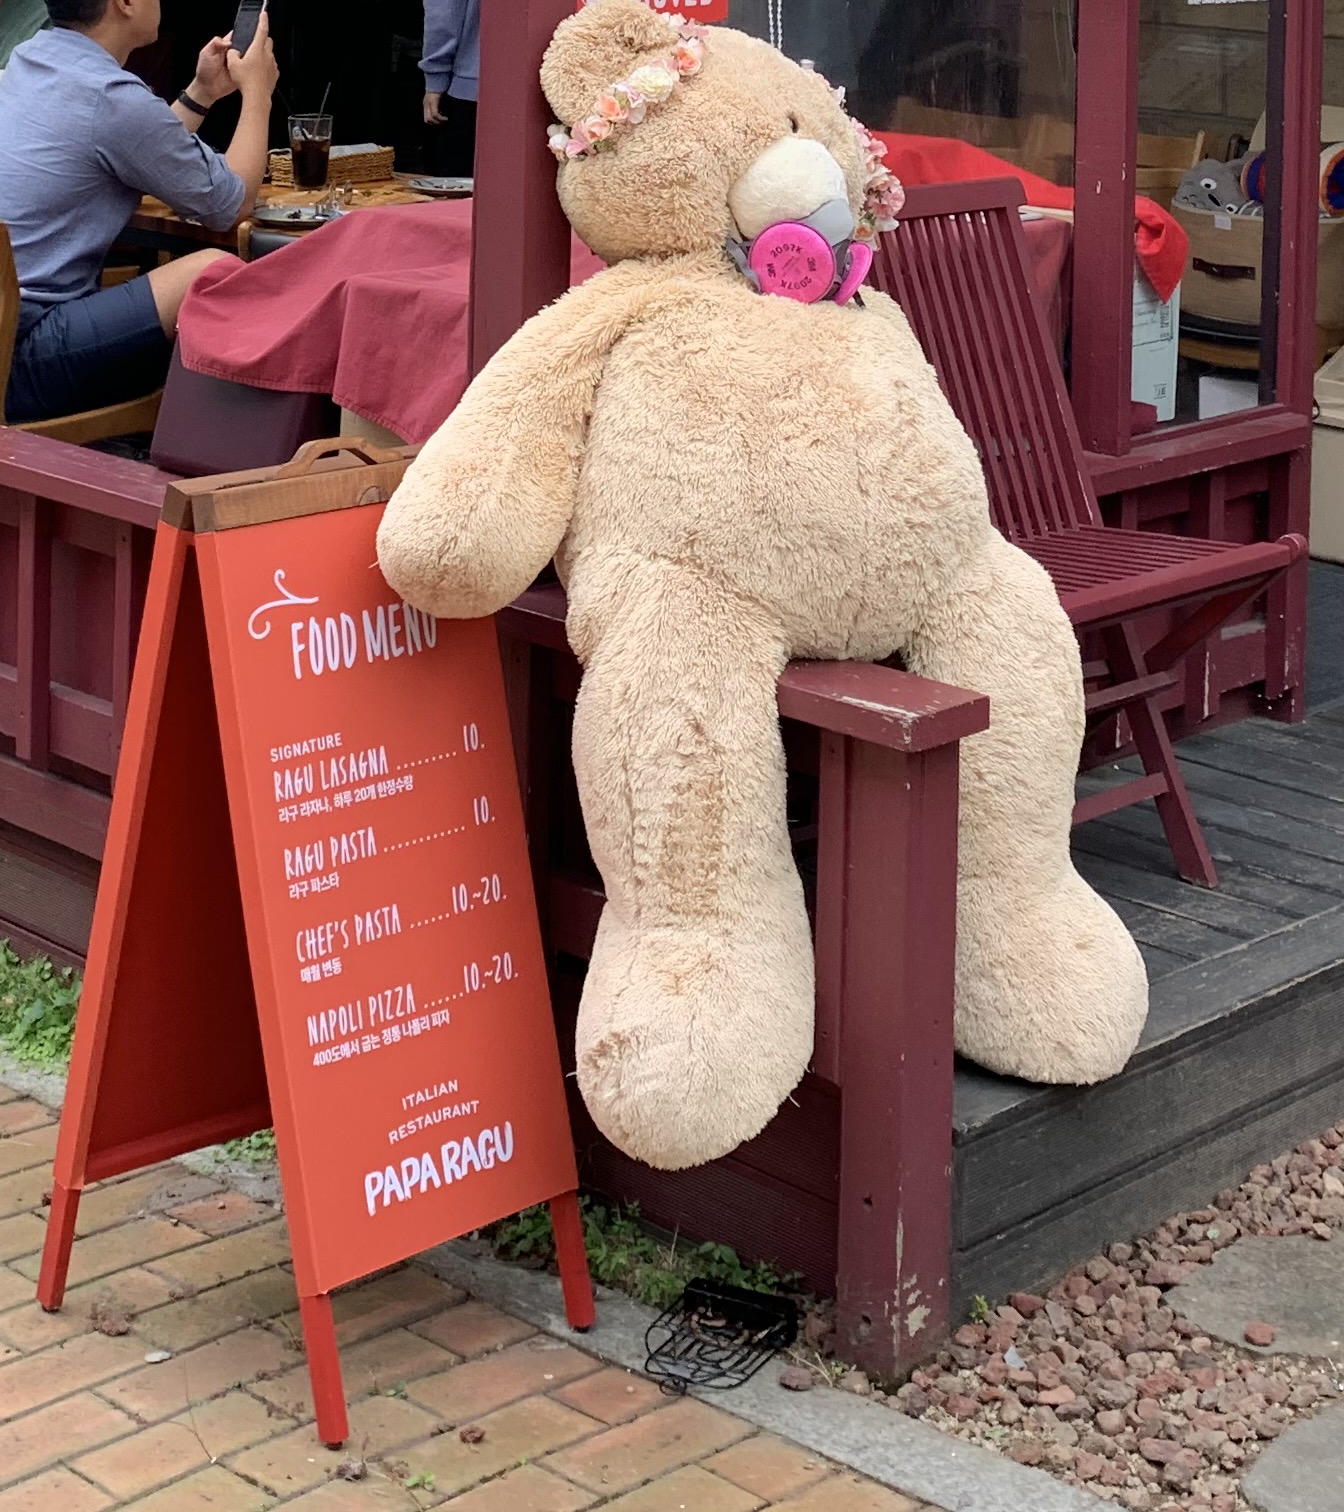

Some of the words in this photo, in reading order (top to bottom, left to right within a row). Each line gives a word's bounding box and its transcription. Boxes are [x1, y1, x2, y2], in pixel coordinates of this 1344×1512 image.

[291, 612, 358, 680] FOOD
[362, 600, 437, 664] MENU
[270, 732, 343, 763] SIGNATURE
[274, 763, 314, 803] RAGU
[320, 745, 389, 791] LASAGNA
[278, 806, 299, 824] 라구
[300, 800, 333, 818] 라자냐,
[333, 791, 353, 809] 하루
[354, 785, 376, 803] 20개
[377, 774, 414, 798] 한정수량
[284, 839, 325, 881] RAGU
[330, 826, 378, 868] PASTA
[289, 882, 309, 900] 라구
[310, 872, 340, 895] 파스타
[296, 919, 349, 963] CHEF'S
[354, 903, 402, 946] PASTA
[300, 963, 321, 984] 매월
[322, 957, 343, 978] 변동
[307, 999, 364, 1047] NAPOLI
[368, 983, 417, 1028] PIZZA
[312, 1044, 361, 1067] 400도에서
[361, 1034, 381, 1054] 굽는
[381, 1028, 402, 1046] 정통
[402, 1018, 431, 1038] 나폴리
[432, 1008, 451, 1027] 피자
[388, 1100, 480, 1145] RESTAURANT
[401, 1079, 459, 1111] ITALIAN
[364, 1151, 442, 1216] PAPA
[441, 1120, 514, 1185] RAGU
